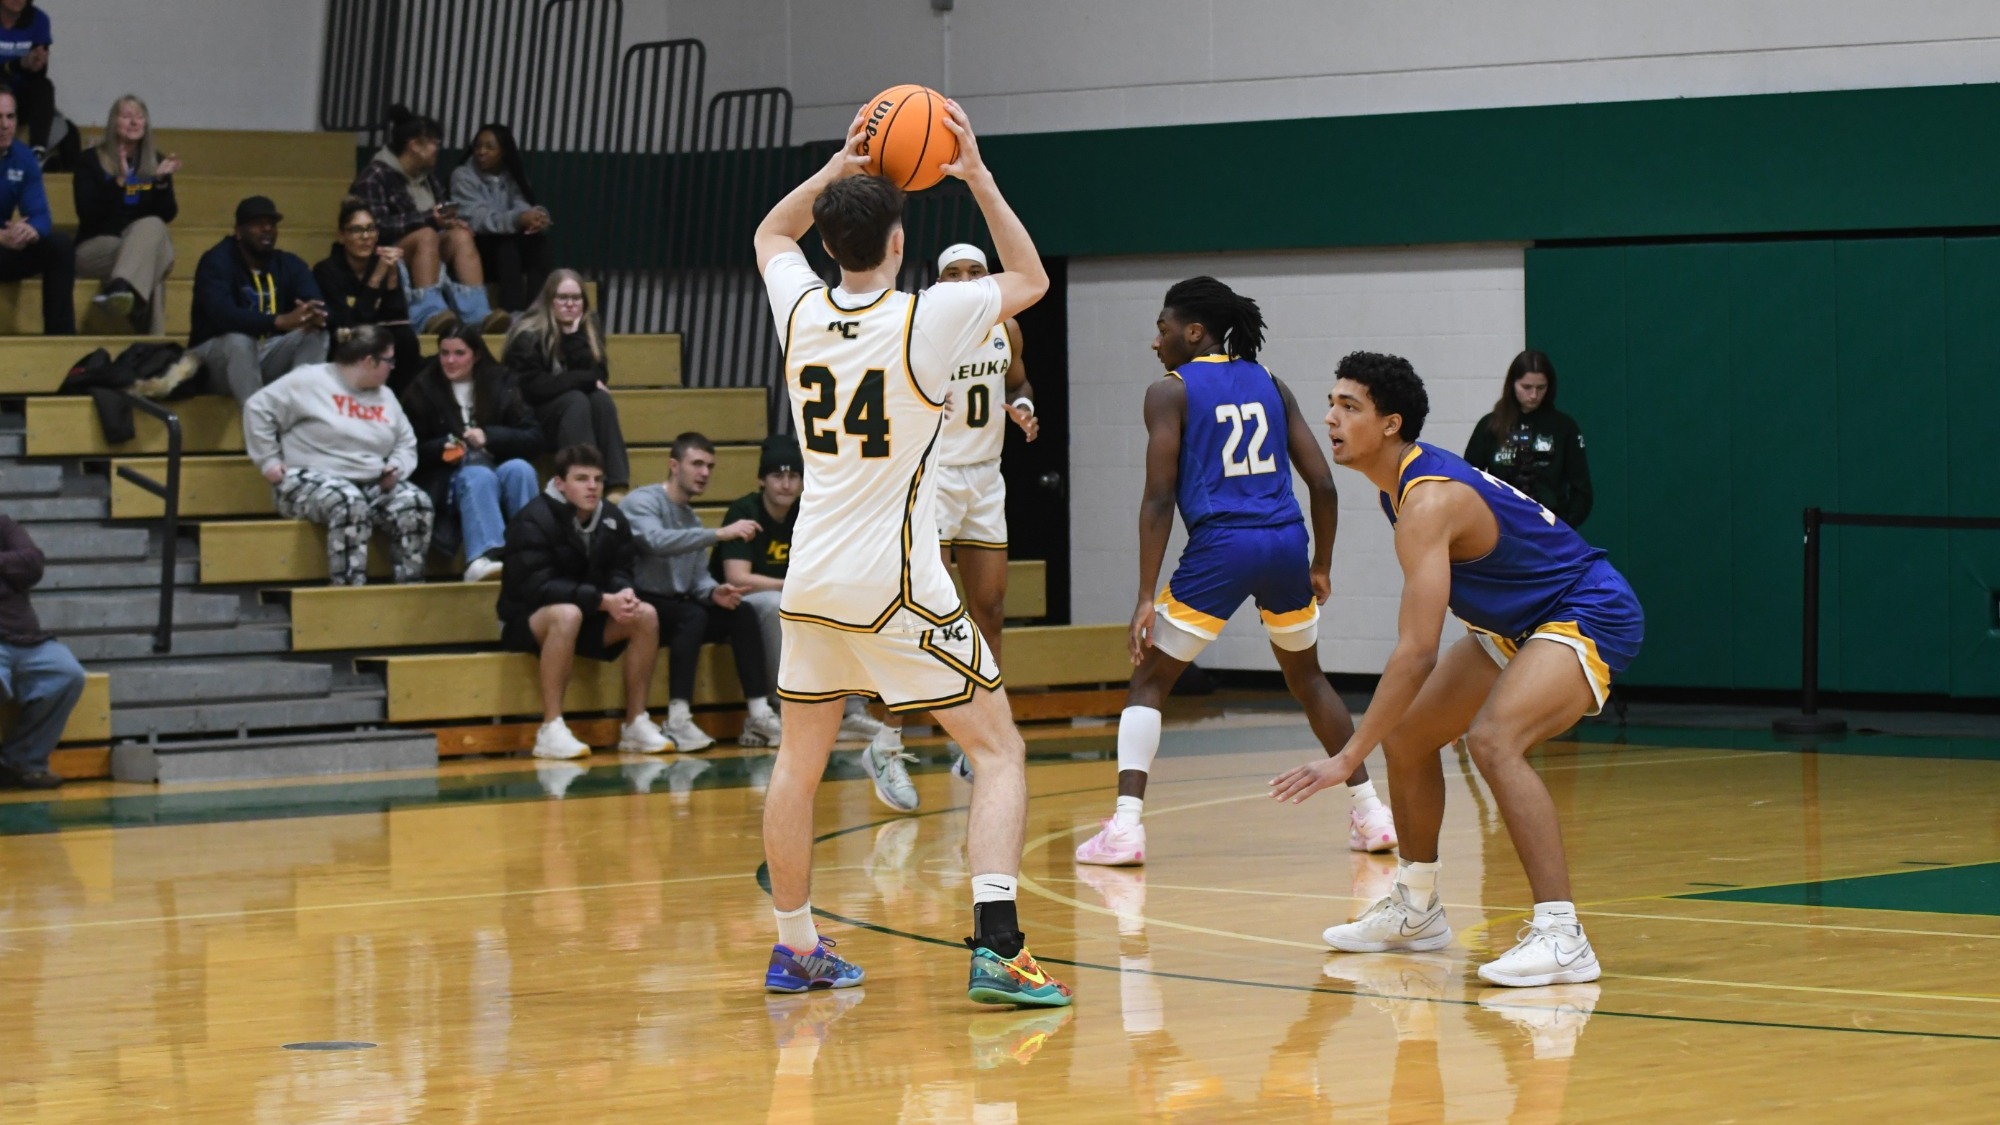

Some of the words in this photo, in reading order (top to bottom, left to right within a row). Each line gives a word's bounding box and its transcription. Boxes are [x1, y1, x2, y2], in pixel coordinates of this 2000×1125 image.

[950, 358, 1008, 381] EUKA
[799, 364, 891, 459] 24
[966, 384, 989, 428] 0
[1215, 402, 1276, 477] 22
